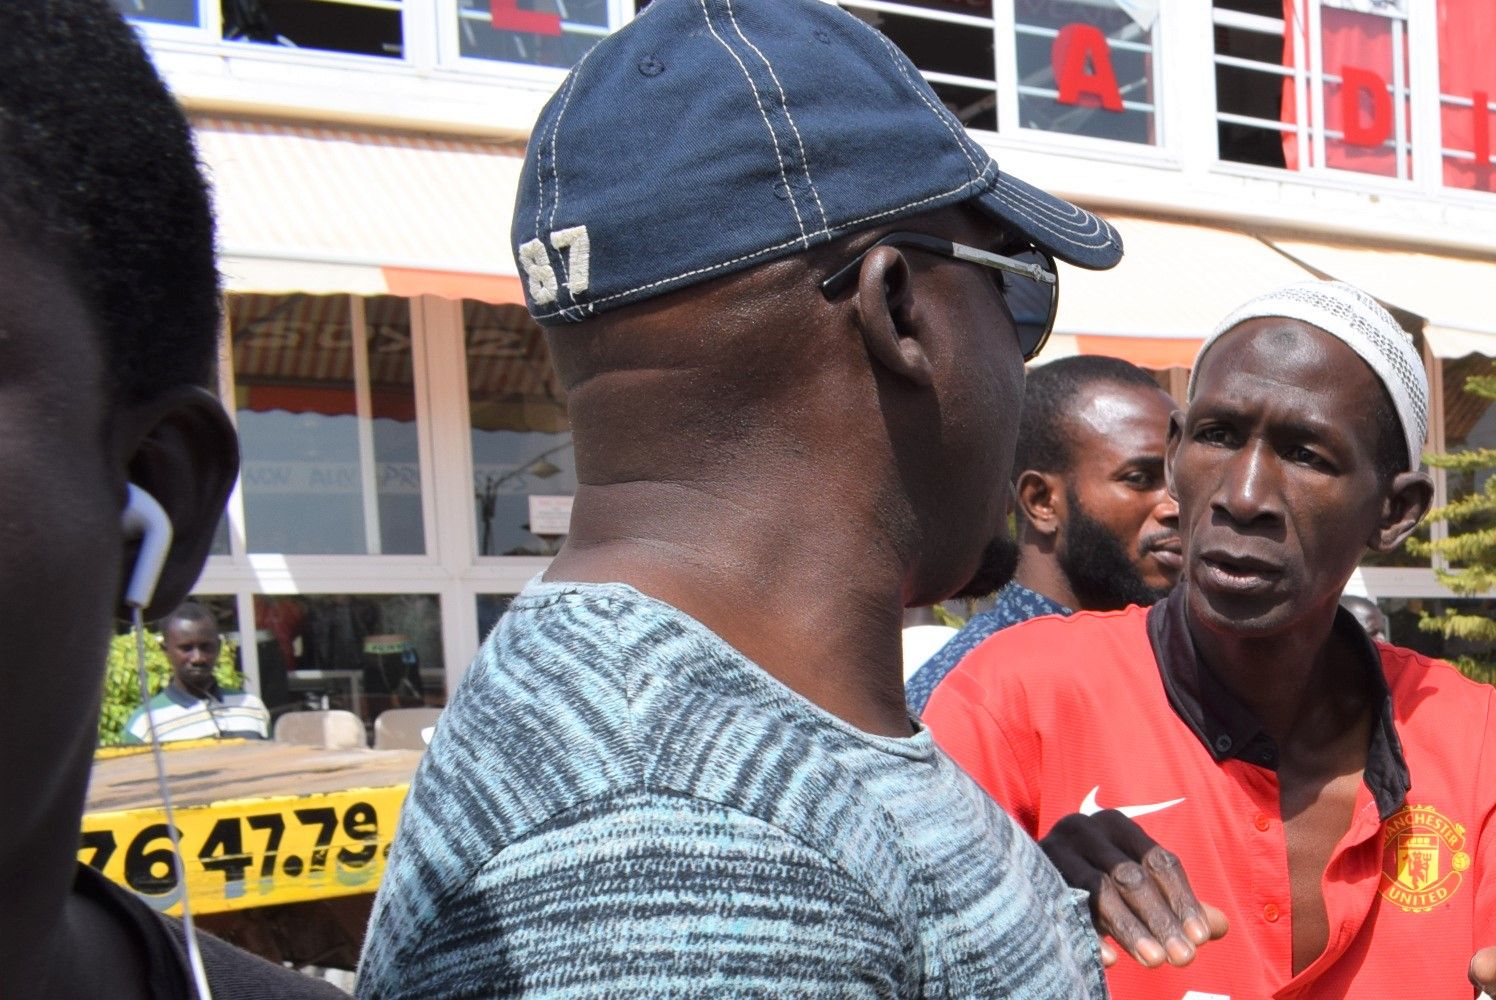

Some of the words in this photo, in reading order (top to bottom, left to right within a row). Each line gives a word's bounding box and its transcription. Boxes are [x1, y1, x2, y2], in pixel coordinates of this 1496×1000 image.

[519, 225, 591, 306] 87
[1385, 813, 1458, 847] ANCHESTER
[1388, 886, 1448, 906] UNITED
